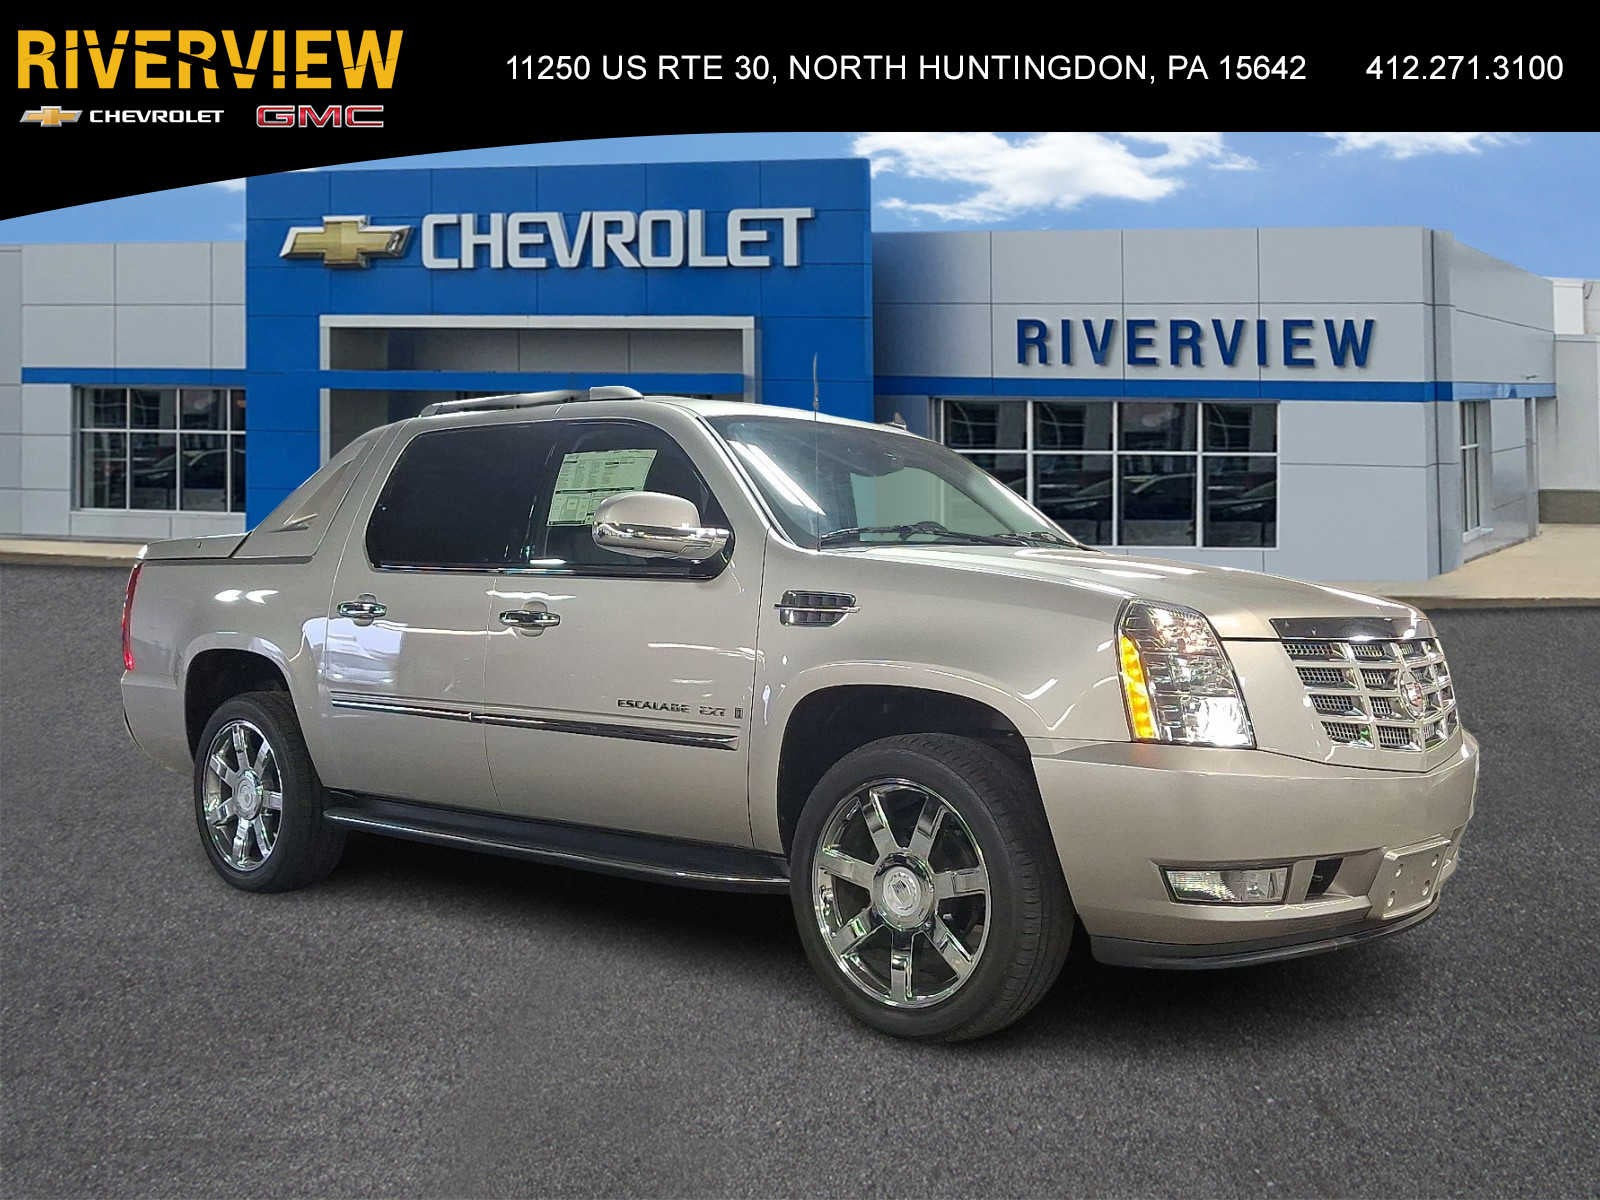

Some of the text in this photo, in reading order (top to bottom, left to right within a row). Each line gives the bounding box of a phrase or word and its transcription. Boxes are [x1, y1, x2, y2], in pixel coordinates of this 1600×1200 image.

[421, 207, 814, 269] CHEVROLET
[1016, 318, 1375, 367] RIVERVIEW
[617, 699, 725, 717] ESCALADE EXT
